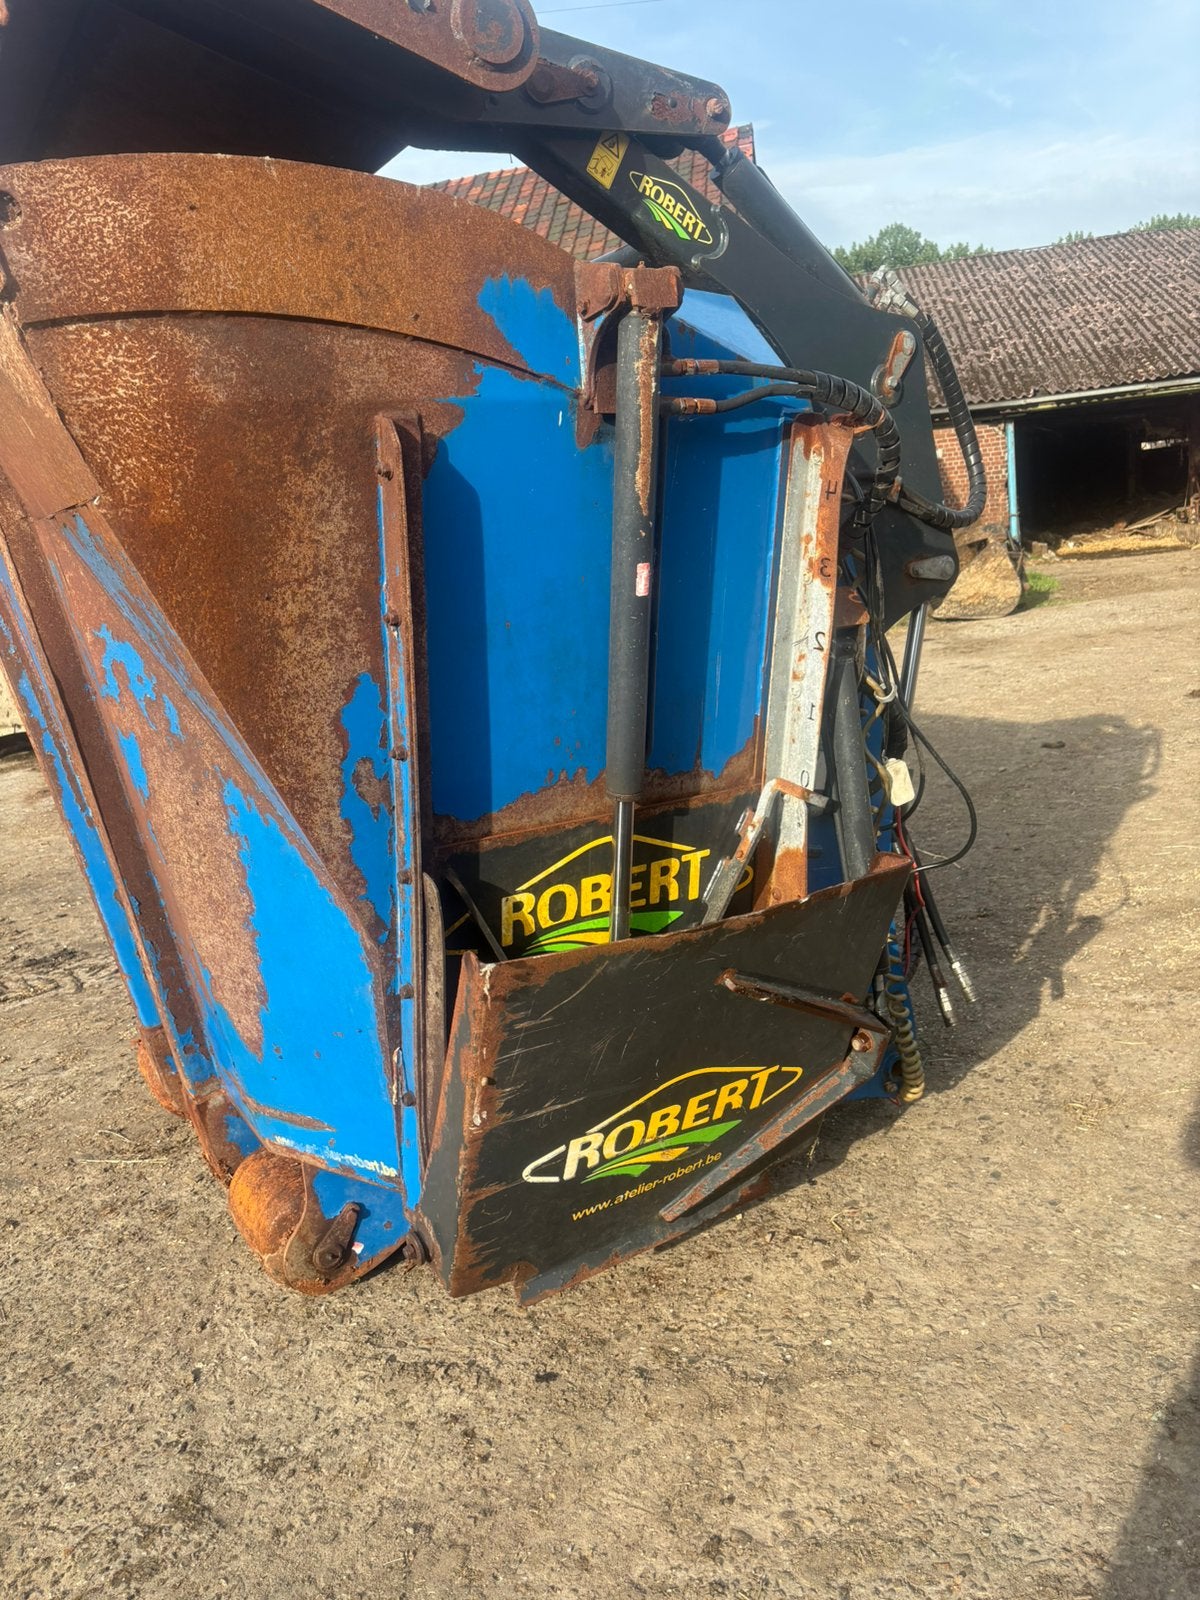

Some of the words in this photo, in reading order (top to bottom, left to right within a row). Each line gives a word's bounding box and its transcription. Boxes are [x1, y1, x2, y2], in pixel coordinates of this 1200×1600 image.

[638, 174, 707, 240] ROBERT
[501, 849, 711, 947] ROBERT
[563, 1064, 780, 1181] ROBERT
[572, 1152, 722, 1221] www.atelier-robert.be
